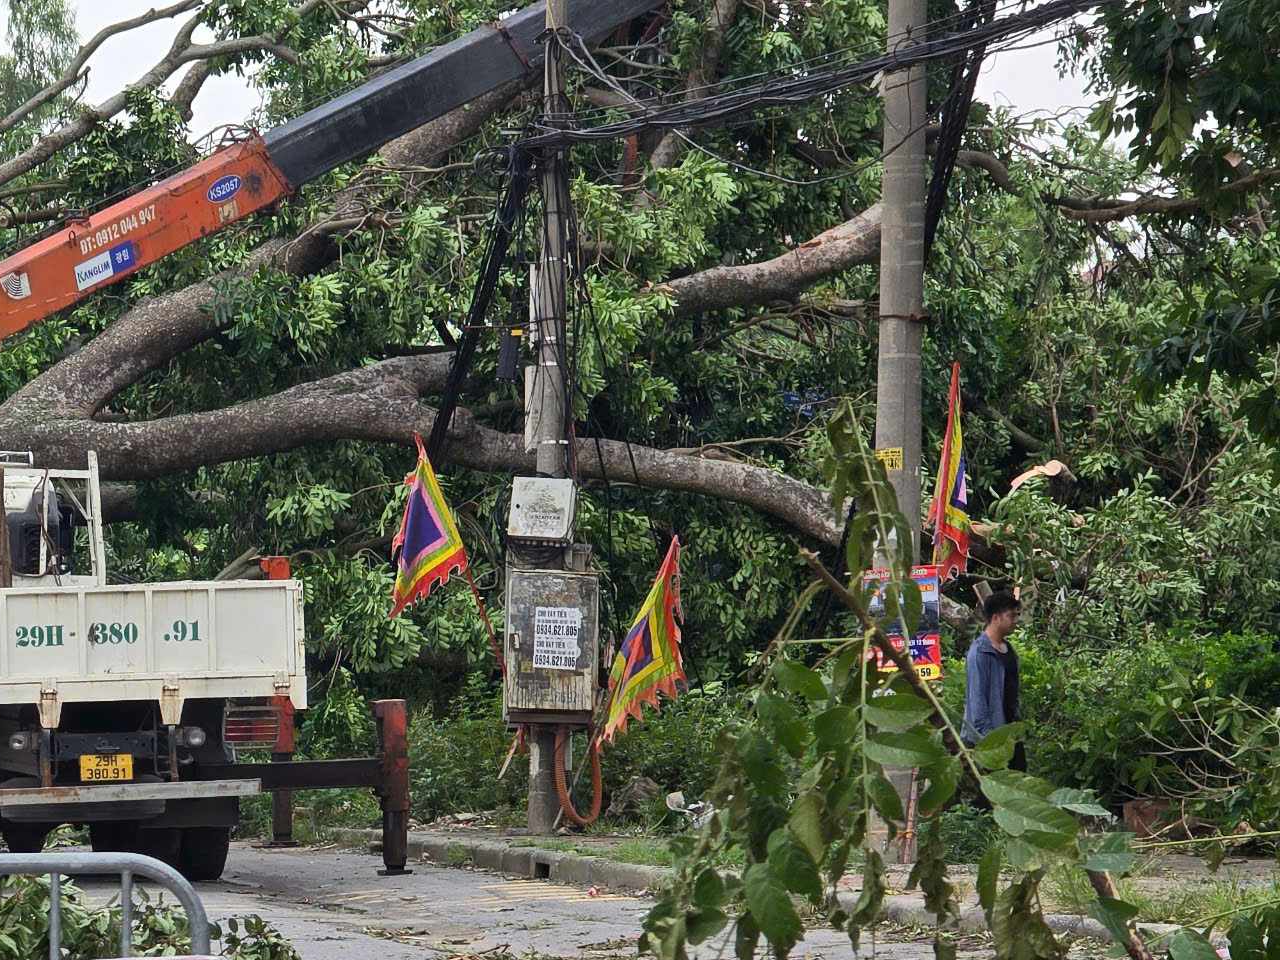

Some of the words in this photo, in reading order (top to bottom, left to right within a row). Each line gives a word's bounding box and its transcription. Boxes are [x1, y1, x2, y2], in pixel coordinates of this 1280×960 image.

[210, 178, 238, 200] KS2057
[120, 214, 138, 235] 044
[139, 204, 156, 225] 947
[77, 261, 110, 283] KANGLIM
[536, 624, 578, 636] 0934.621.805
[535, 655, 576, 667] 0934.621.805
[95, 756, 117, 767] 29H
[86, 768, 126, 779] 380.91
